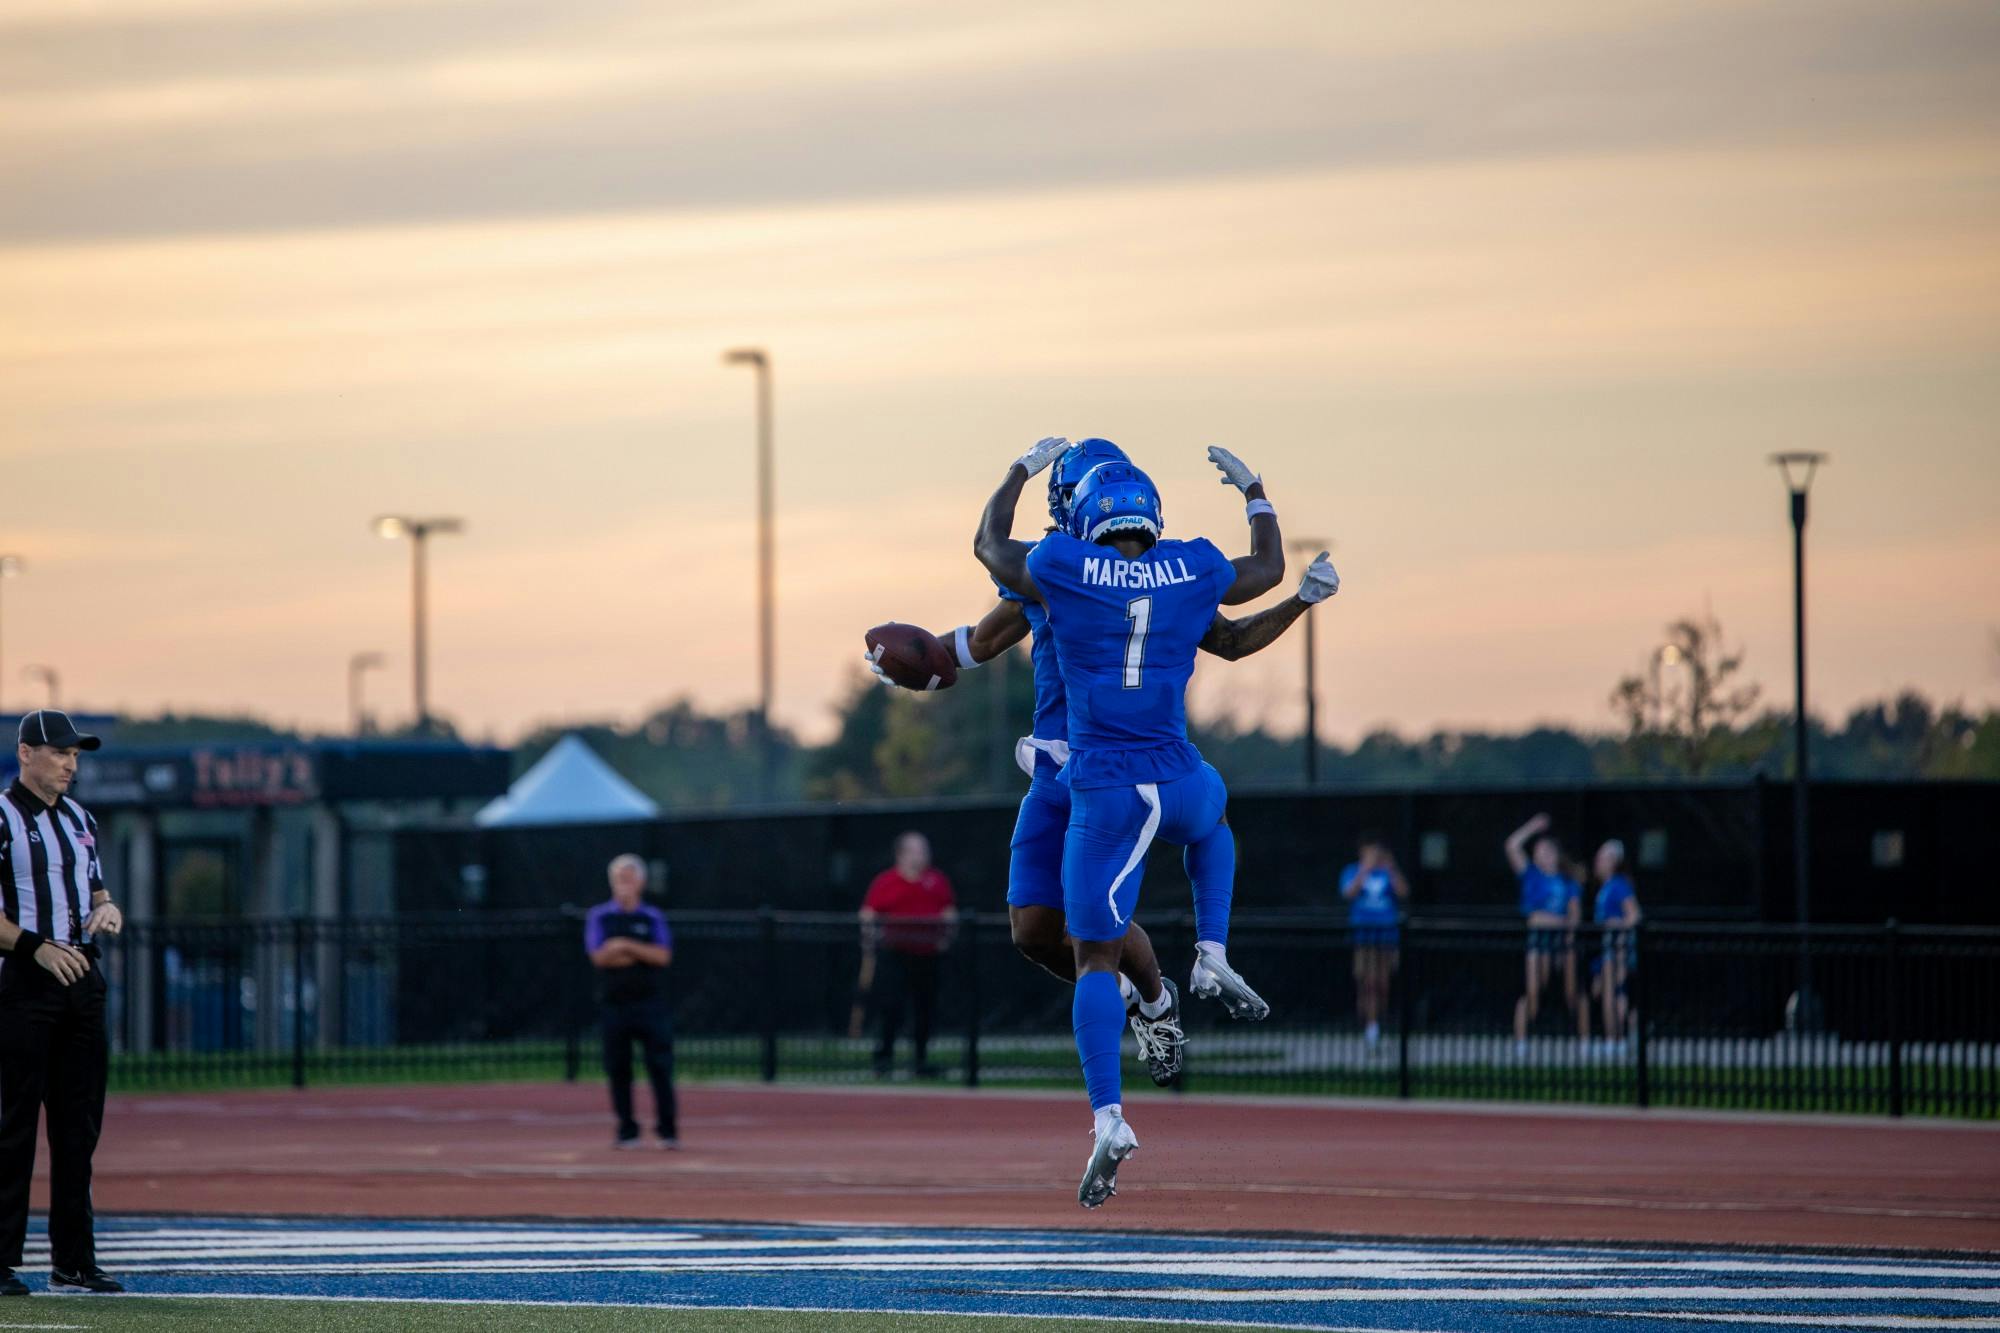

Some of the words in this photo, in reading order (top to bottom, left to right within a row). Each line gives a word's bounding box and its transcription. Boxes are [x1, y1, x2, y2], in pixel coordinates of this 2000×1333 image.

[1110, 517, 1143, 527] BUFFALO
[1083, 557, 1196, 589] MARSHALL
[1123, 595, 1152, 689] 1
[29, 831, 41, 842] S
